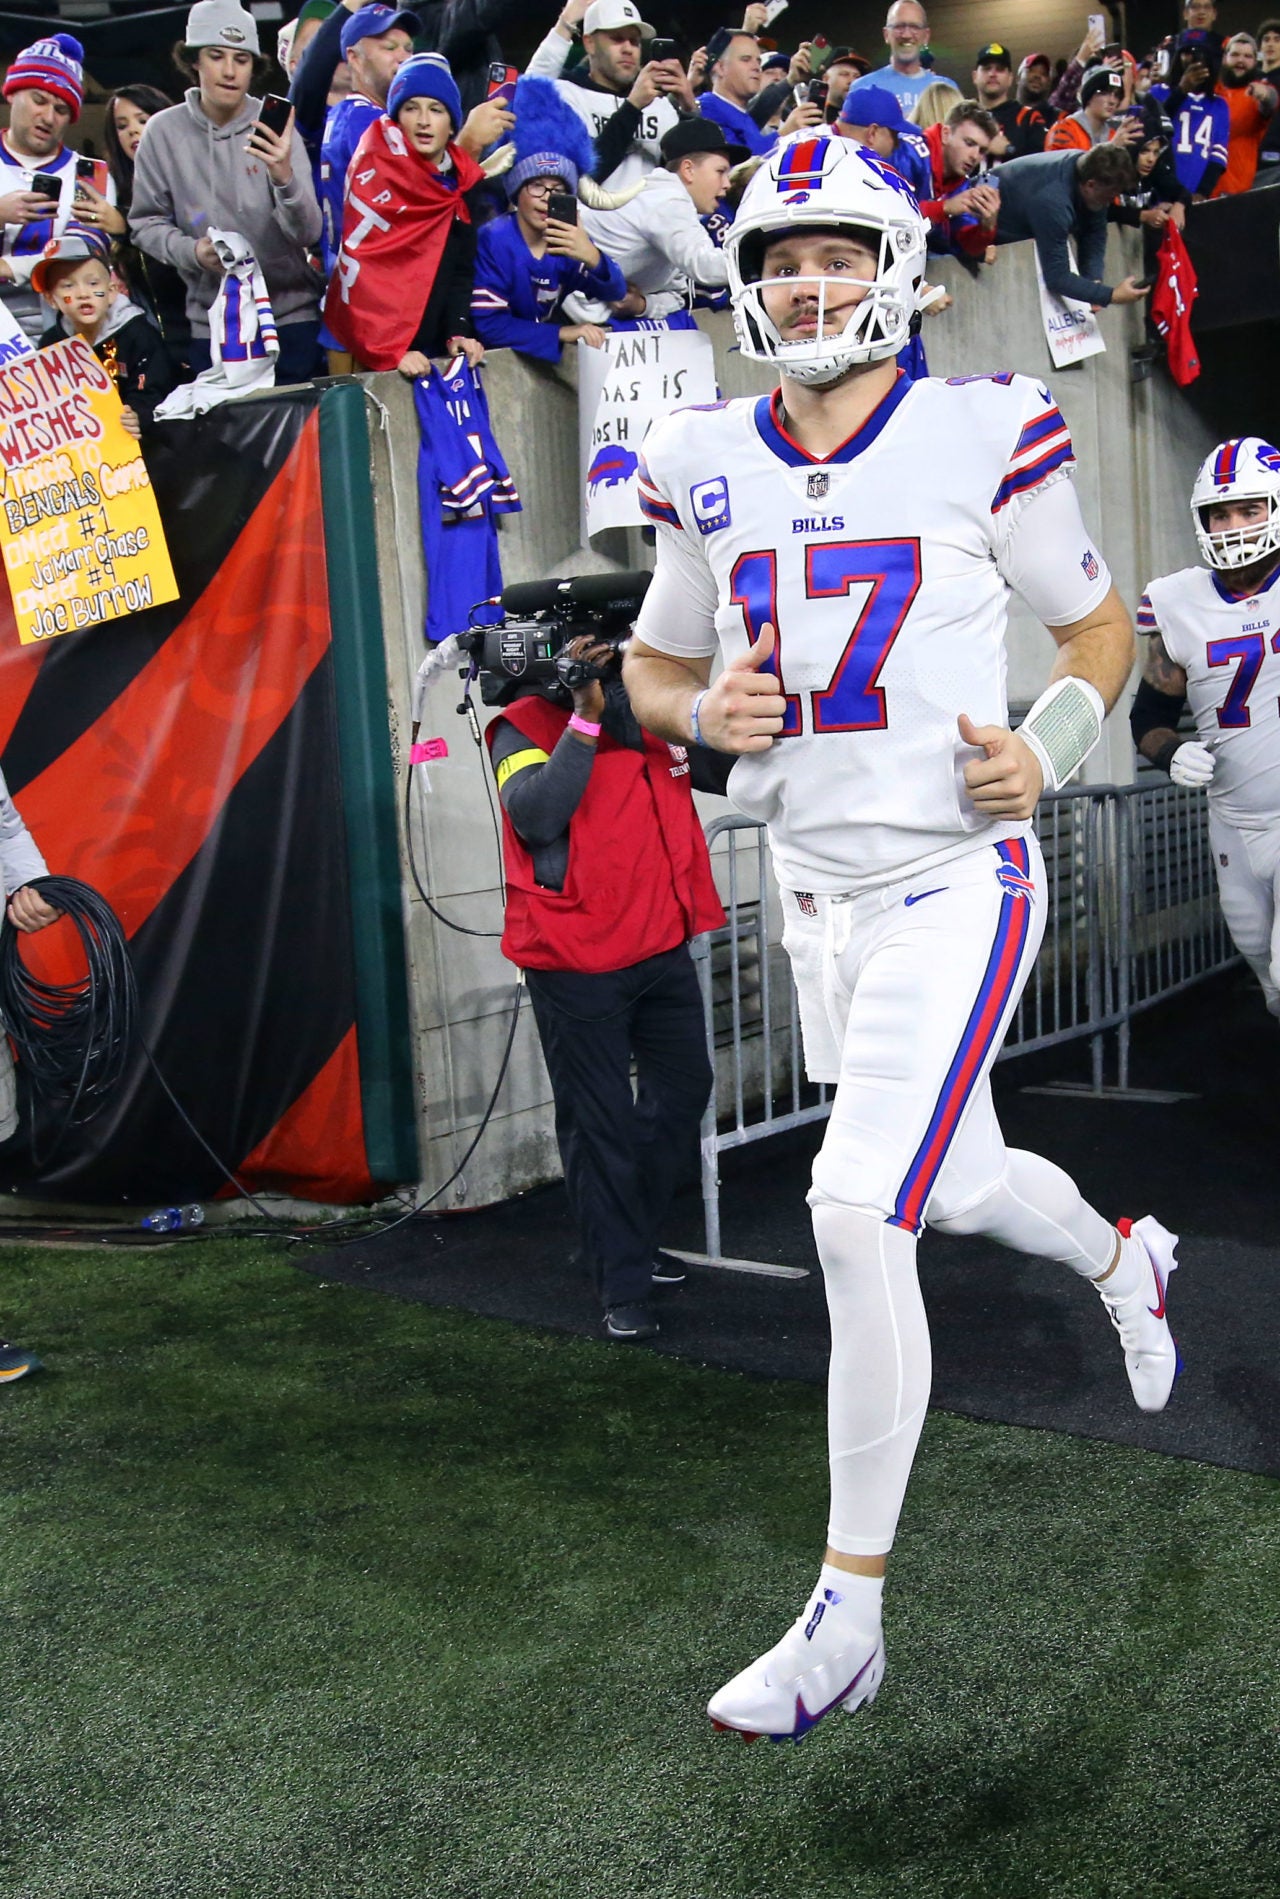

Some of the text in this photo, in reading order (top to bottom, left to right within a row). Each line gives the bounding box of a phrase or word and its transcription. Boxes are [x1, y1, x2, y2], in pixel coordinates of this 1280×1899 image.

[1177, 111, 1213, 159] 14
[605, 335, 661, 368] ANT
[0, 394, 100, 466] WISHES
[5, 471, 100, 534] BENGALS
[792, 516, 845, 534] BILLS
[94, 527, 150, 564] Chase
[30, 604, 68, 638] Joe
[729, 536, 922, 738] 17
[1241, 619, 1270, 632] BILLS
